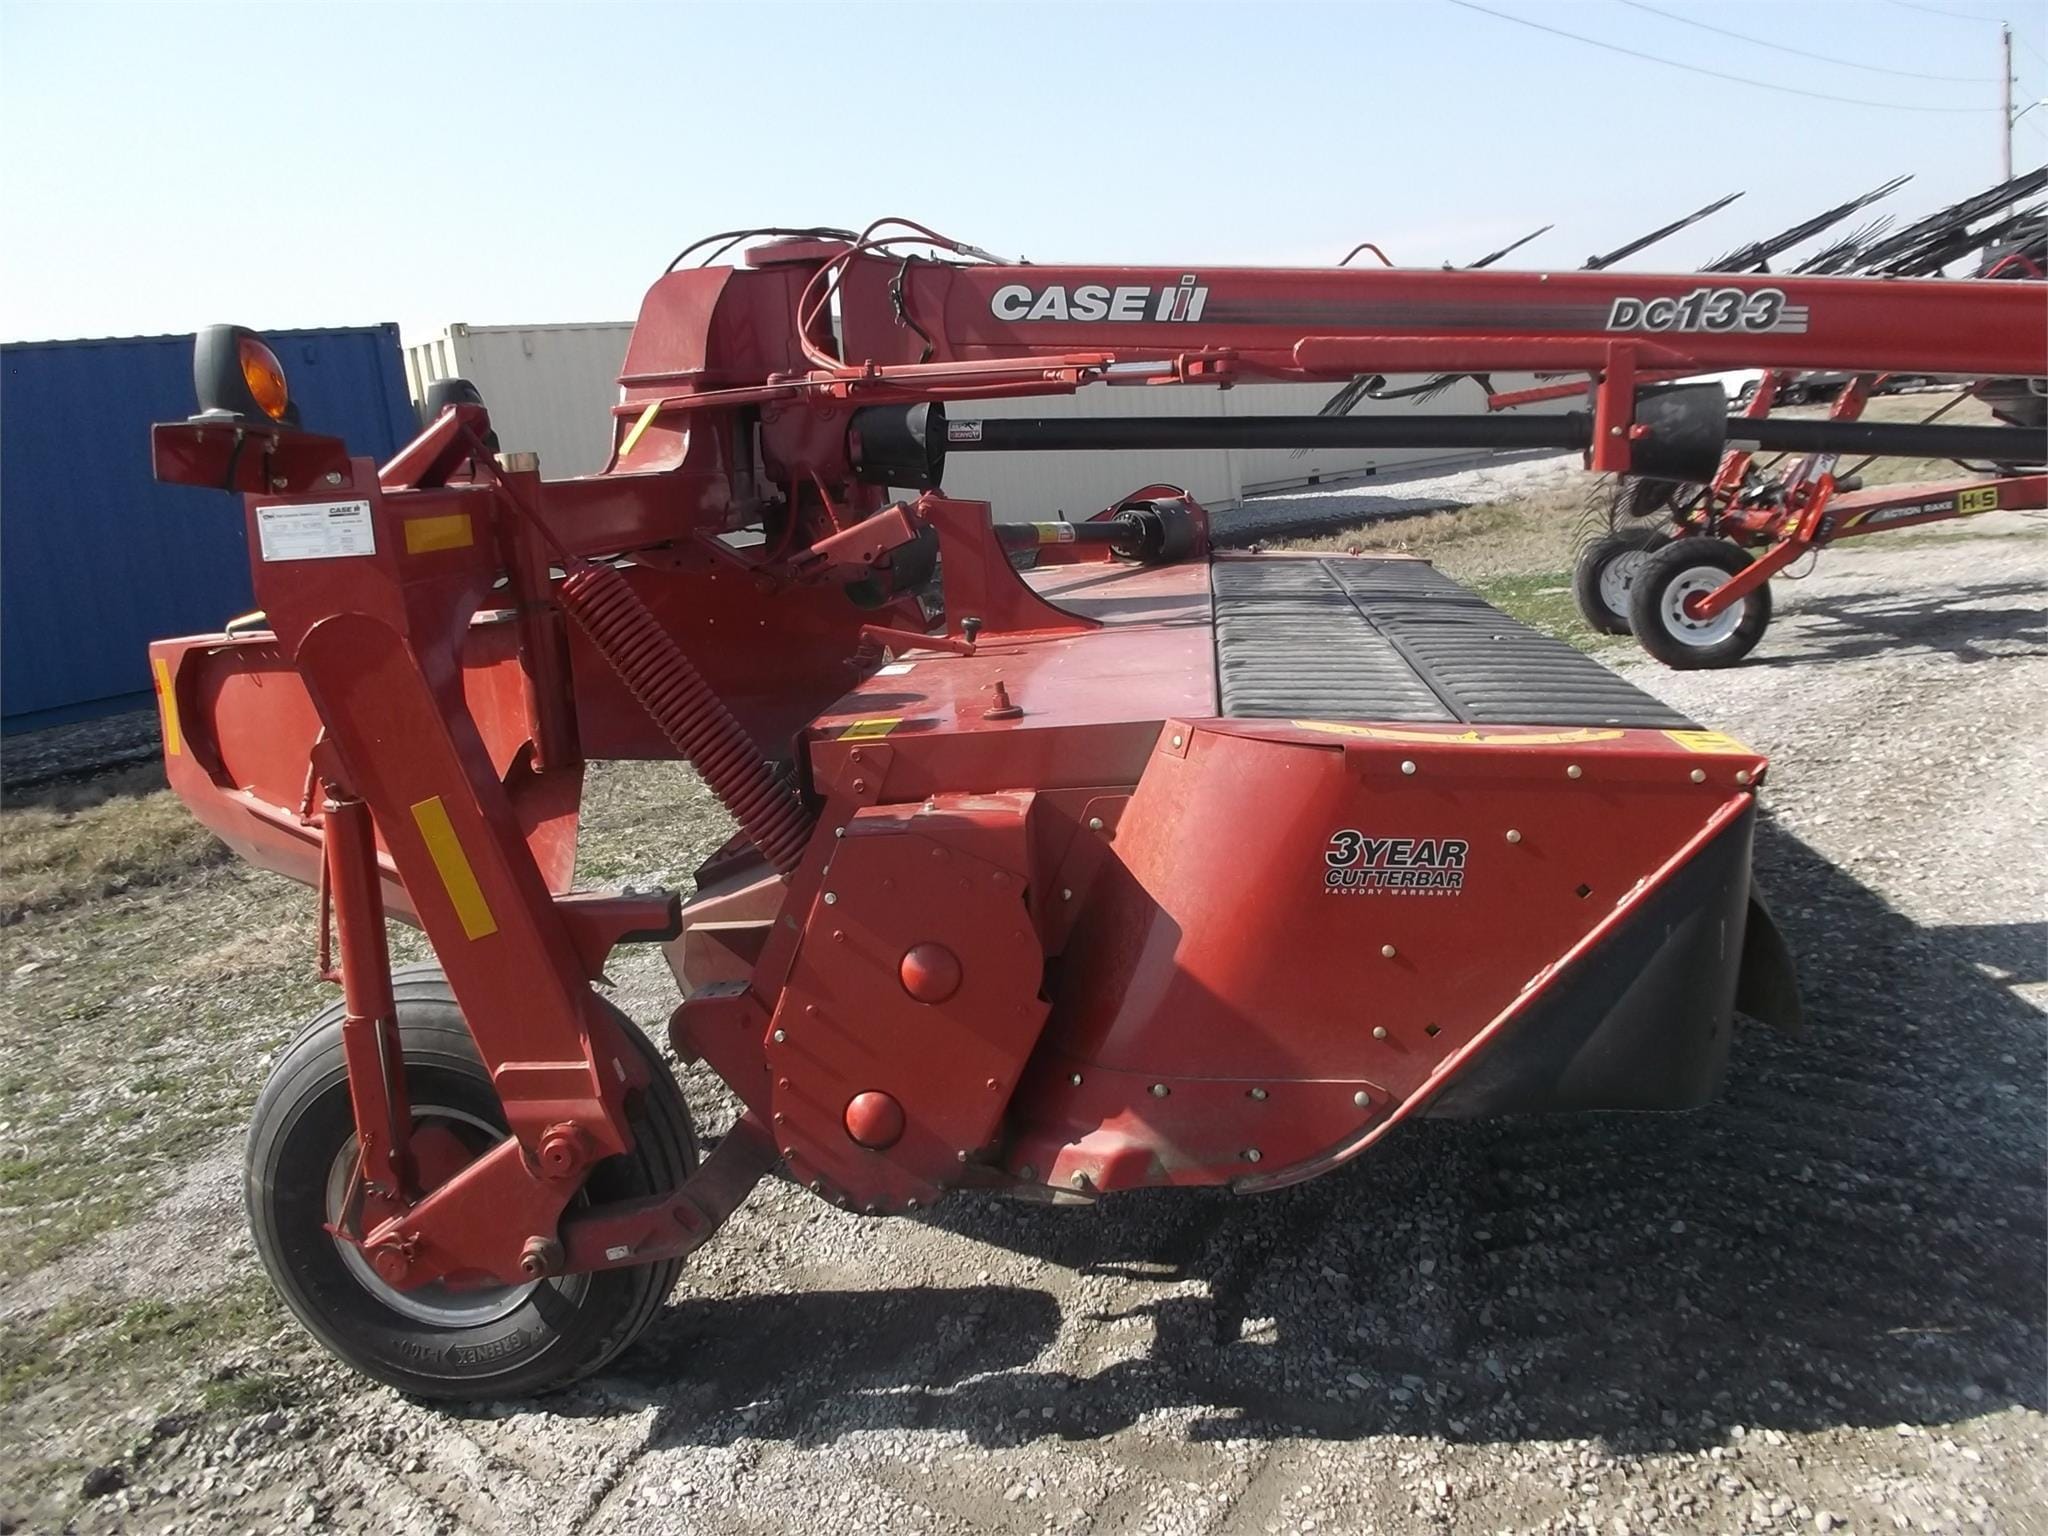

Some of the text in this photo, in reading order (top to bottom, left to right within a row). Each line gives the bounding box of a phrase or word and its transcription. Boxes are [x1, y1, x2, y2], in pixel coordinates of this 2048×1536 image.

[991, 284, 1151, 321] CASE
[1606, 288, 1786, 333] DC133
[329, 506, 352, 514] CASE
[1325, 868, 1464, 888] CUTTERBAR
[1325, 887, 1462, 897] FACTORY WARRANTY
[458, 1334, 521, 1364] GREENEX
